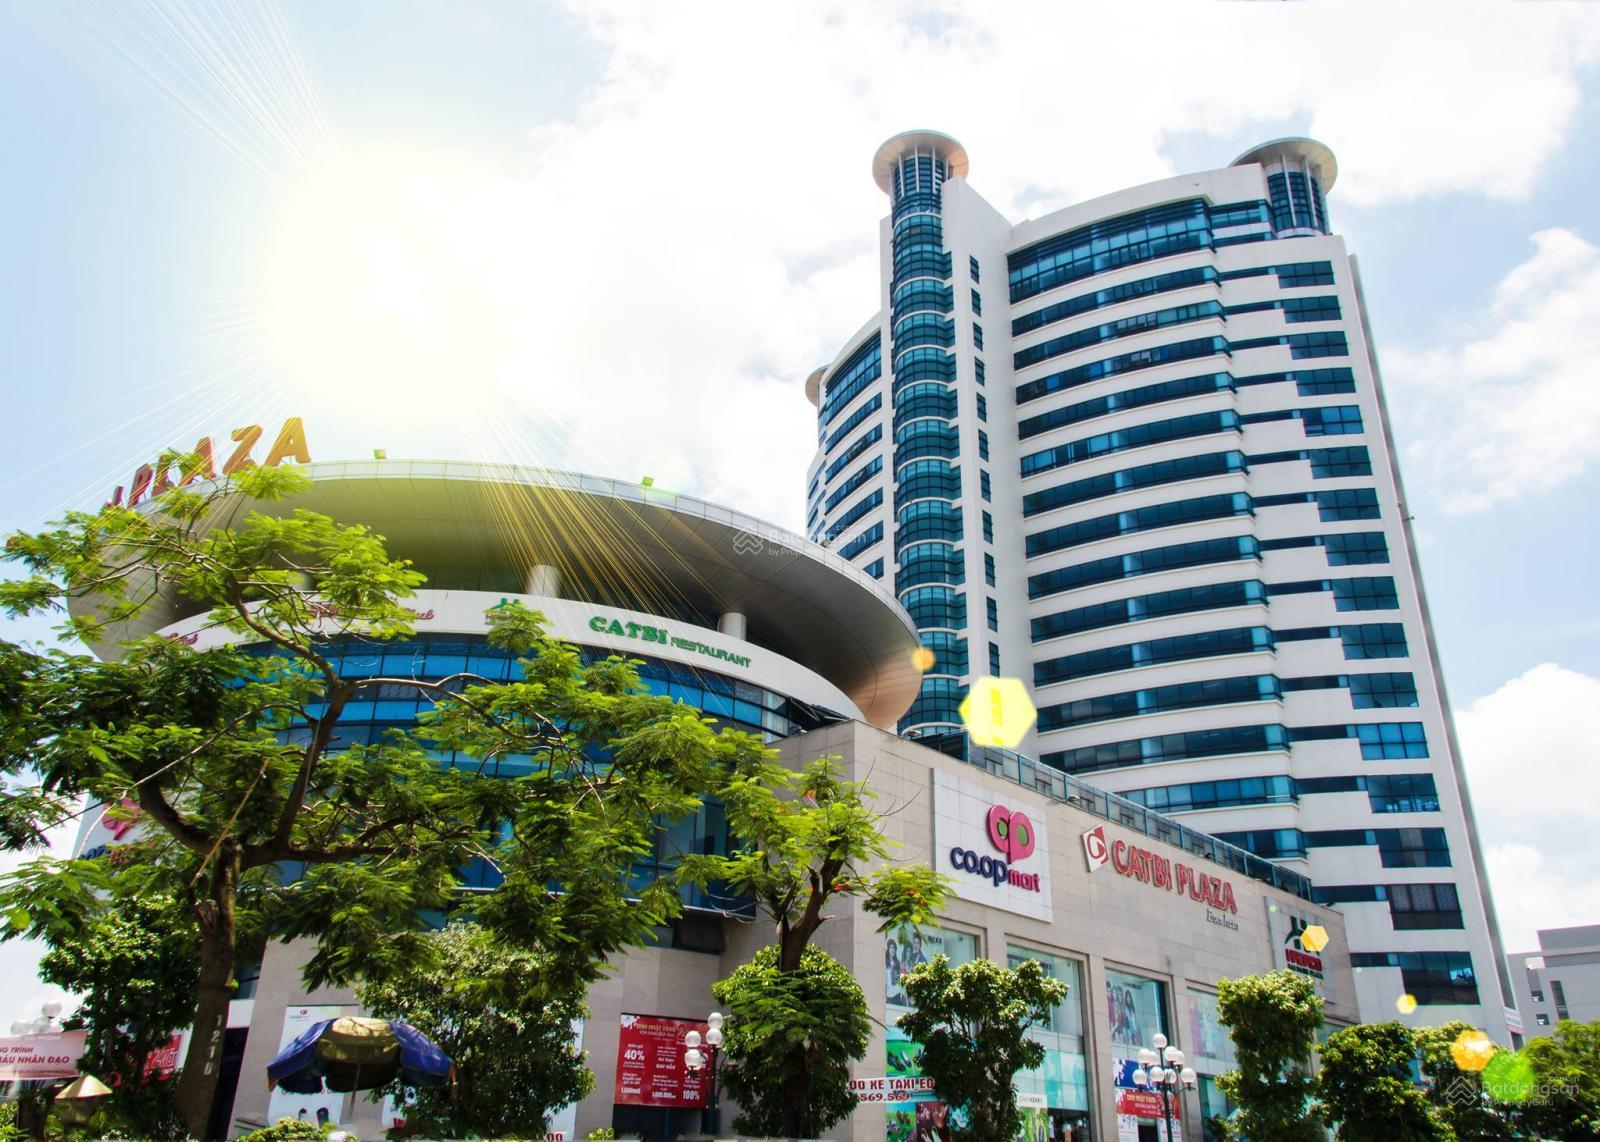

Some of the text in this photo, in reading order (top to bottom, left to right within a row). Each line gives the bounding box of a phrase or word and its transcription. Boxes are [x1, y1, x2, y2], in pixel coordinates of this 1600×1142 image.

[589, 615, 752, 669] CATBI RESTAURANT
[1111, 838, 1238, 915] CATBI PLAZA
[624, 1049, 645, 1061] 40%
[889, 1078, 917, 1090] TAXI
[683, 1090, 700, 1100] 100%
